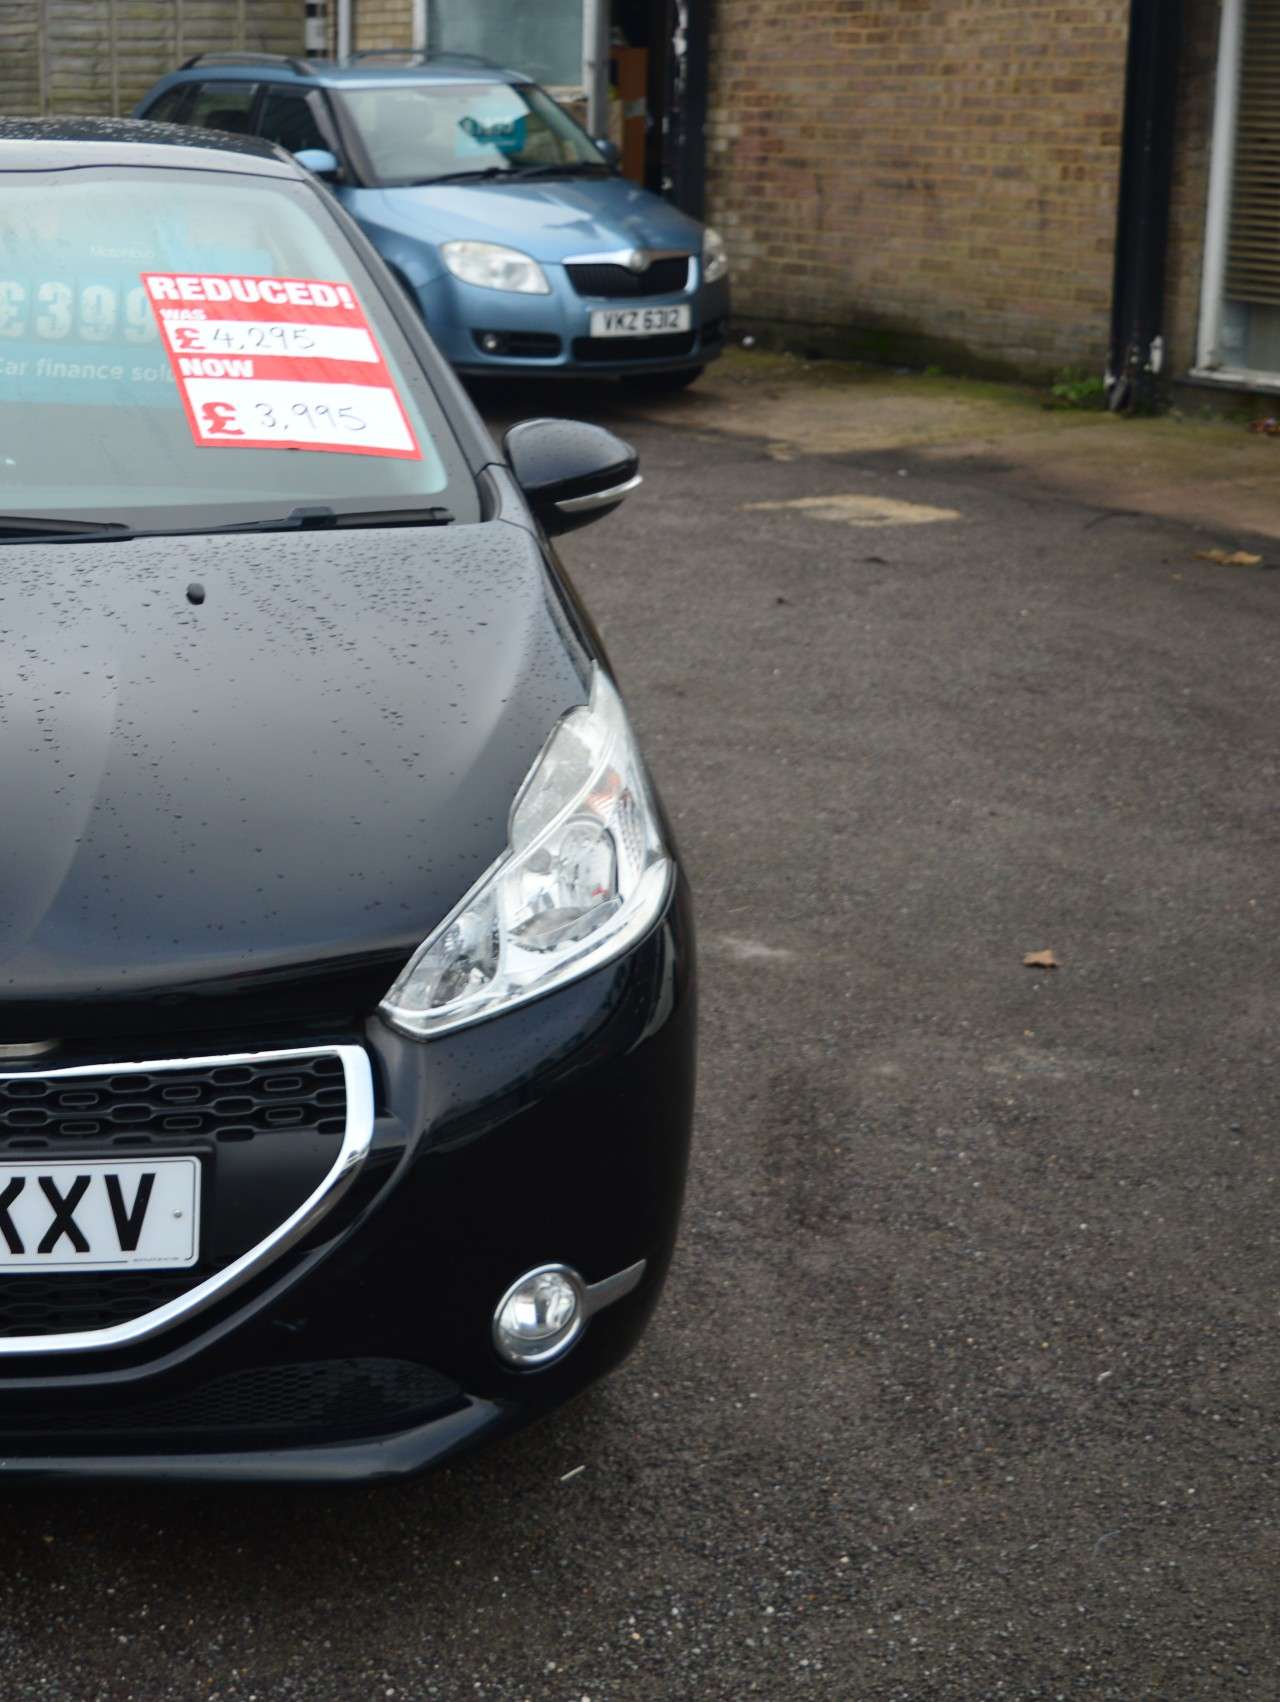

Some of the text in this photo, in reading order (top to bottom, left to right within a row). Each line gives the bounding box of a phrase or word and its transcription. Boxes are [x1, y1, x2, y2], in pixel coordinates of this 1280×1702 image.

[147, 276, 355, 309] REDUCED!
[159, 308, 207, 320] WAS
[604, 308, 680, 331] VKZ 6312
[35, 357, 124, 380] finance
[178, 357, 254, 378] NOW
